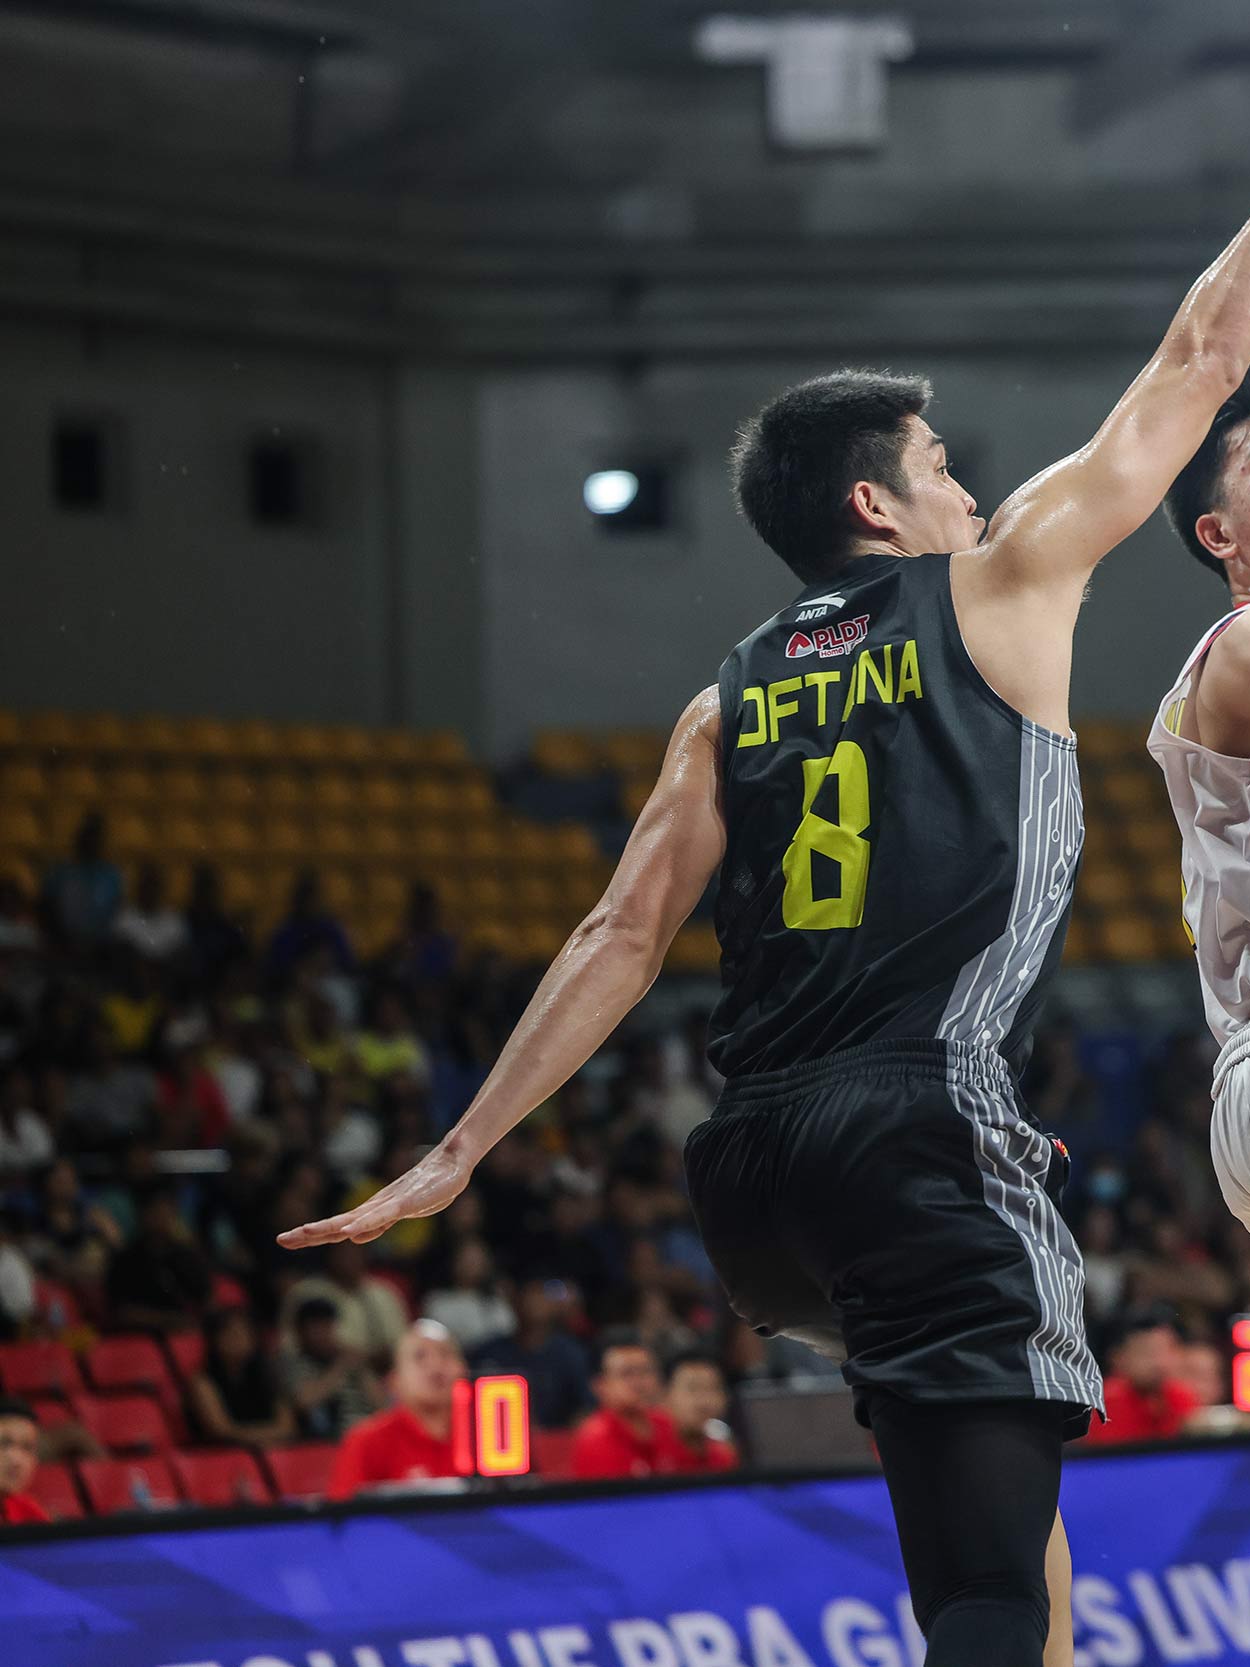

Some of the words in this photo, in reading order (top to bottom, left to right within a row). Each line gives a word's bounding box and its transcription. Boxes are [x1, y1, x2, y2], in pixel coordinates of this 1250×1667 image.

[794, 605, 828, 622] ANTA
[812, 614, 870, 651] PLDT
[820, 647, 844, 658] Home
[782, 740, 871, 930] 8
